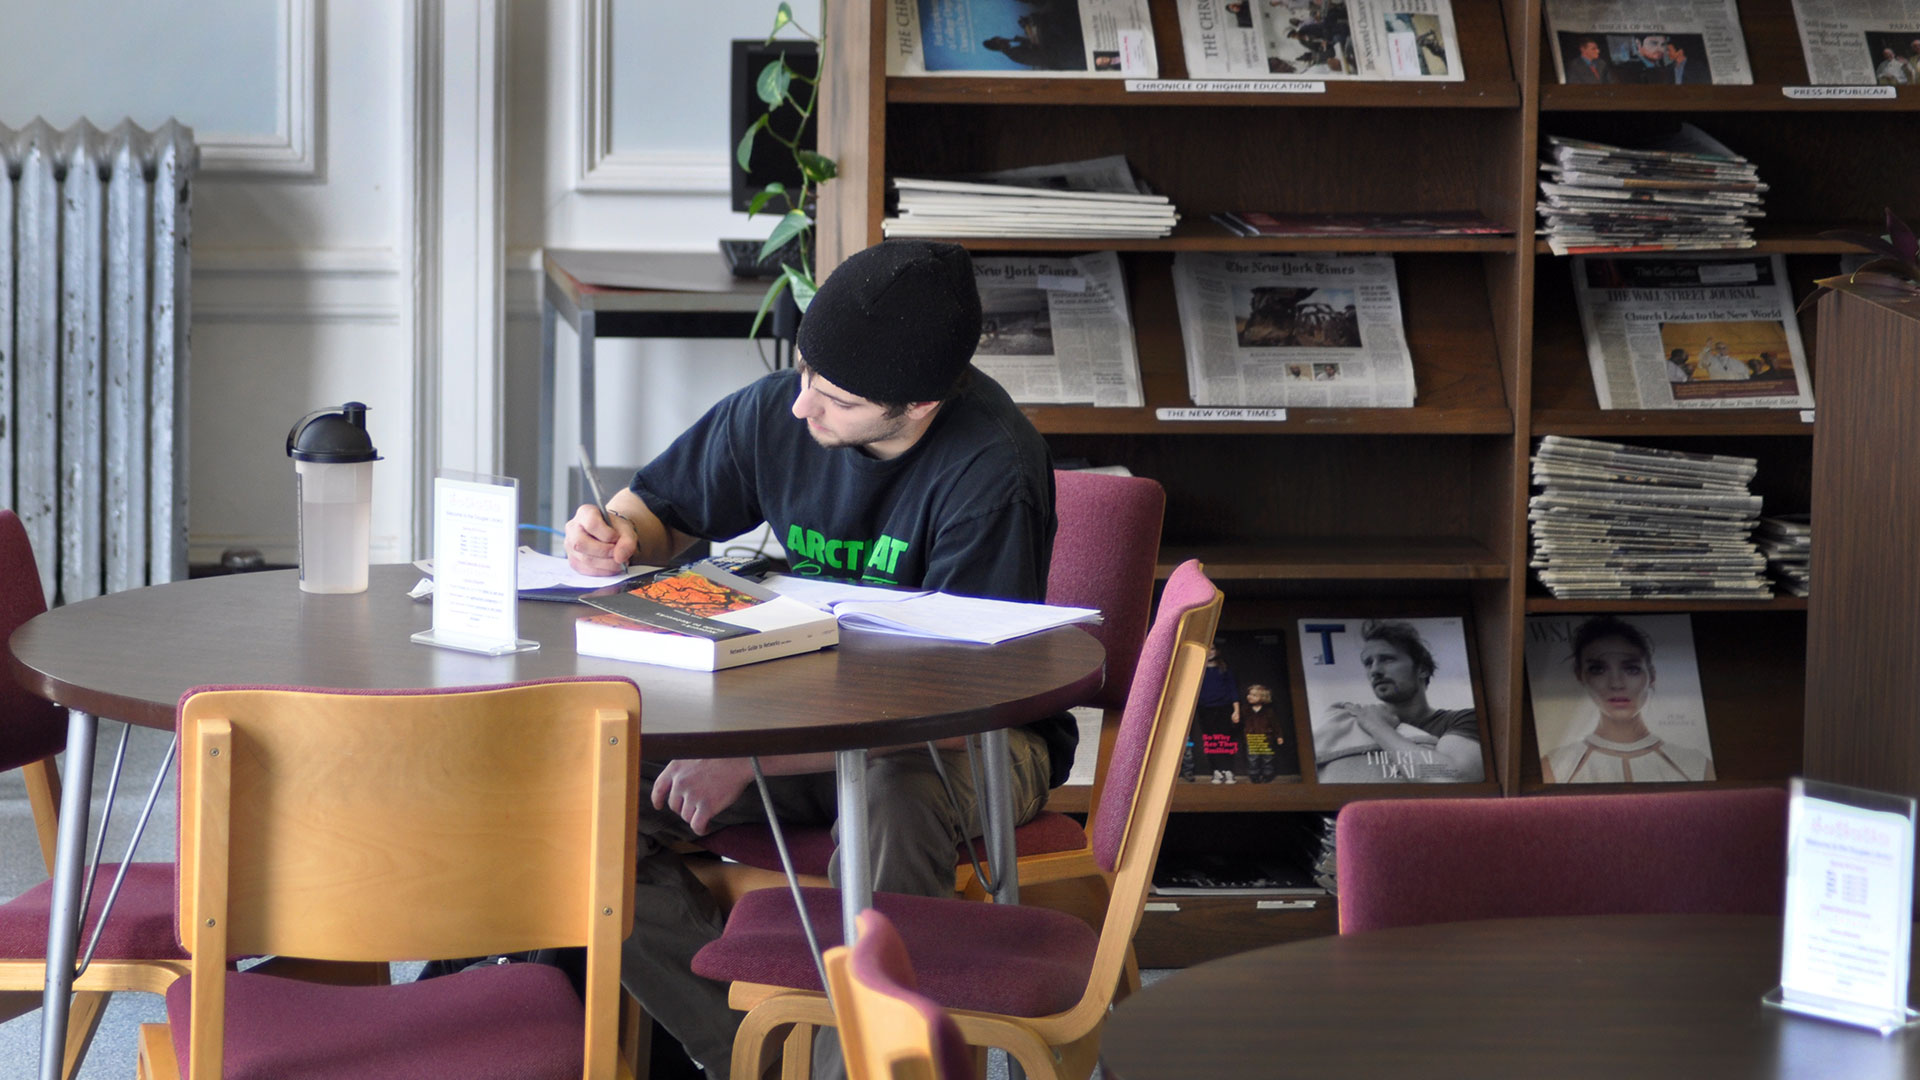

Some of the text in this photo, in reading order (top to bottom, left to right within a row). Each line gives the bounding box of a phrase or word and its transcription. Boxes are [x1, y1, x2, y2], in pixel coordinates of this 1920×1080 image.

[1197, 0, 1218, 60] THE CHR
[1135, 82, 1191, 90] CHRONICLE
[1793, 88, 1887, 96] PRESS-REPUBLICAN
[974, 264, 1079, 279] New York Times
[1226, 261, 1355, 276] The New York Times
[1607, 290, 1630, 302] THE
[1632, 289, 1661, 302] WALL
[1664, 289, 1706, 302] STREET
[1624, 309, 1782, 321] Church Looks to the New World
[1166, 409, 1278, 418] THE NEW YORK TIMES
[868, 534, 909, 575] AT
[1304, 624, 1346, 665] T
[1212, 734, 1231, 742] Why
[1203, 747, 1238, 755] Smiling?
[1217, 741, 1238, 749] They
[1366, 751, 1392, 765] THE
